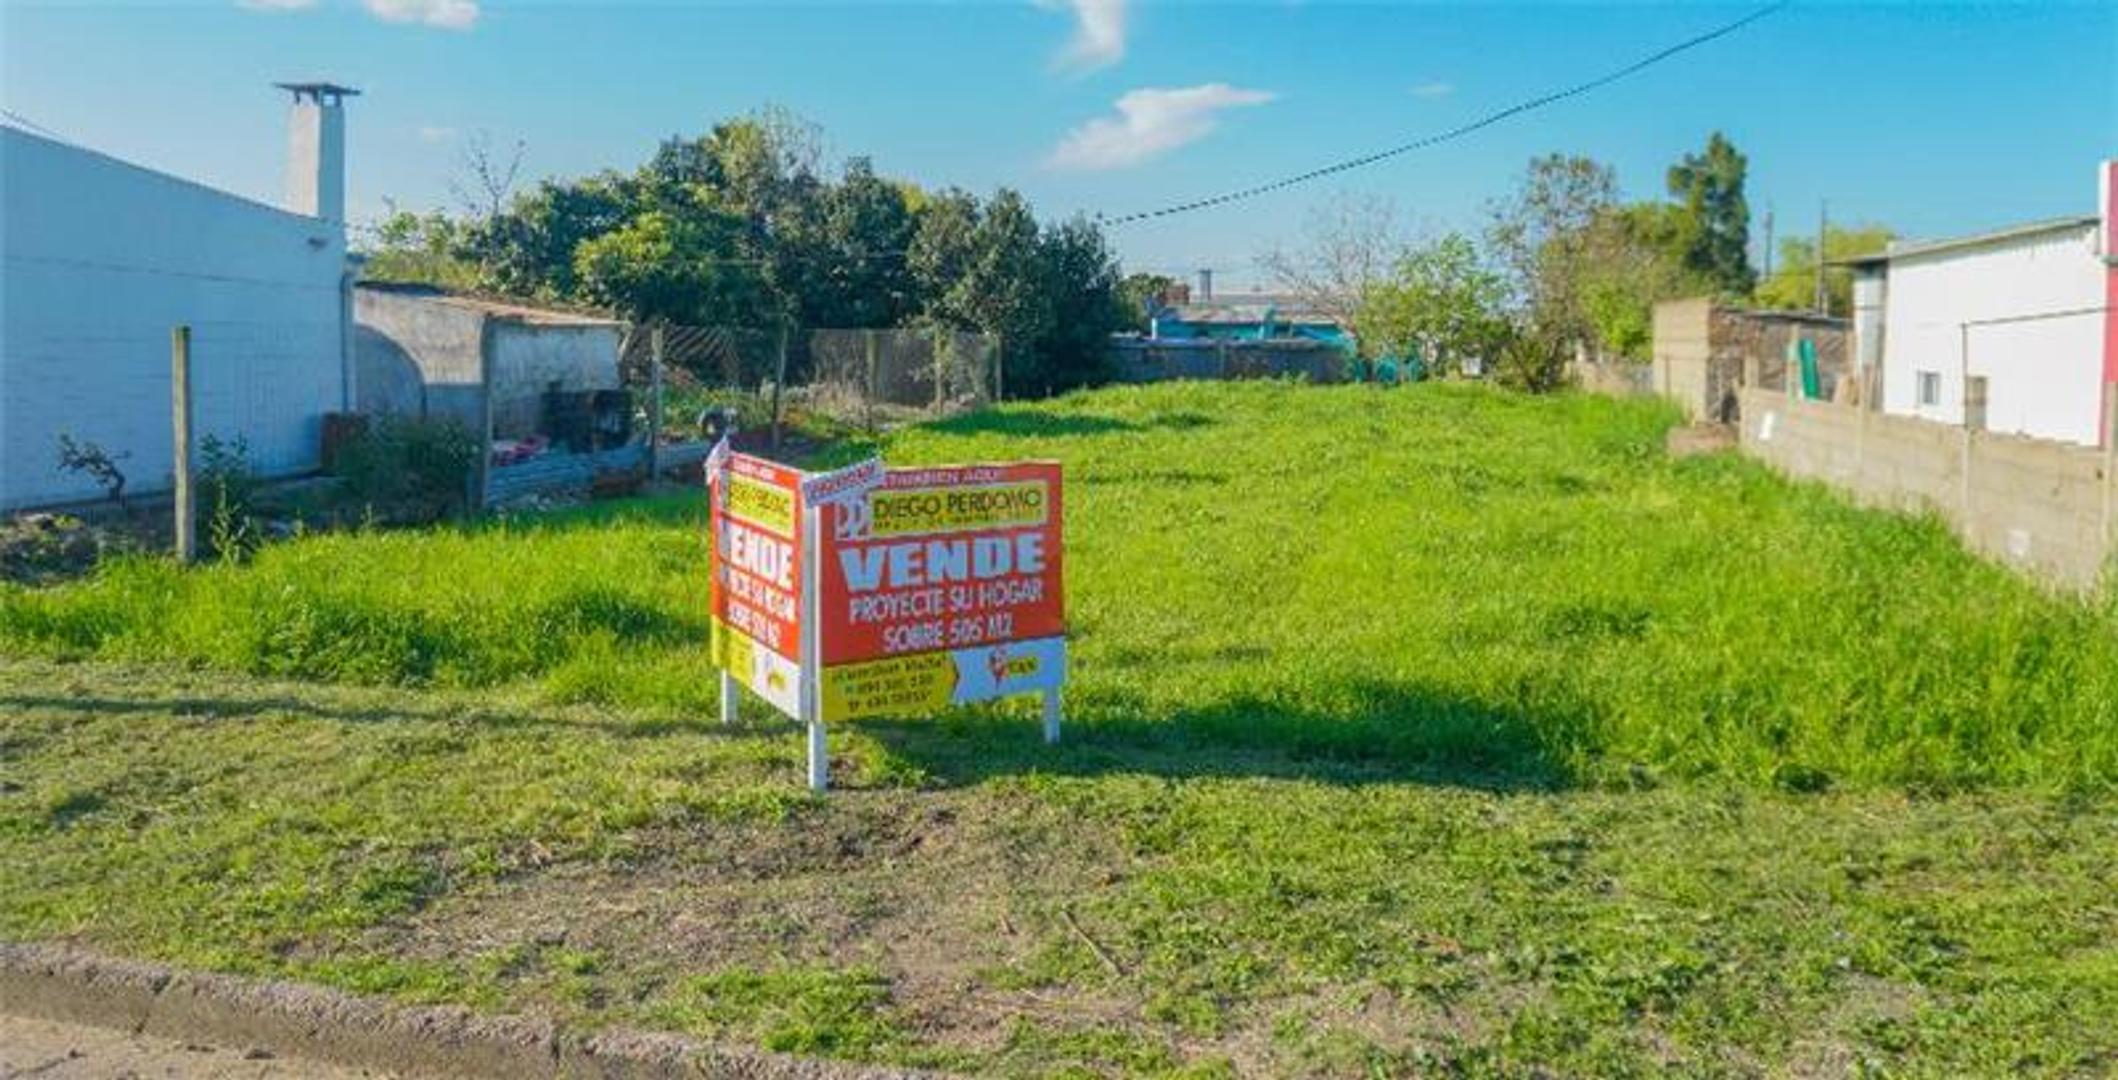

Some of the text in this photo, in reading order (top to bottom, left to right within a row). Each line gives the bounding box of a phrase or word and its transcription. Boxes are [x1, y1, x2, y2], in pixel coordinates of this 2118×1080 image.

[874, 495, 941, 519] DIEGO
[949, 489, 1041, 514] PERDOMO
[839, 533, 1047, 590] VENDE
[850, 578, 1042, 623] PROYECTE SU HOGAR
[883, 621, 944, 652] SOBRE
